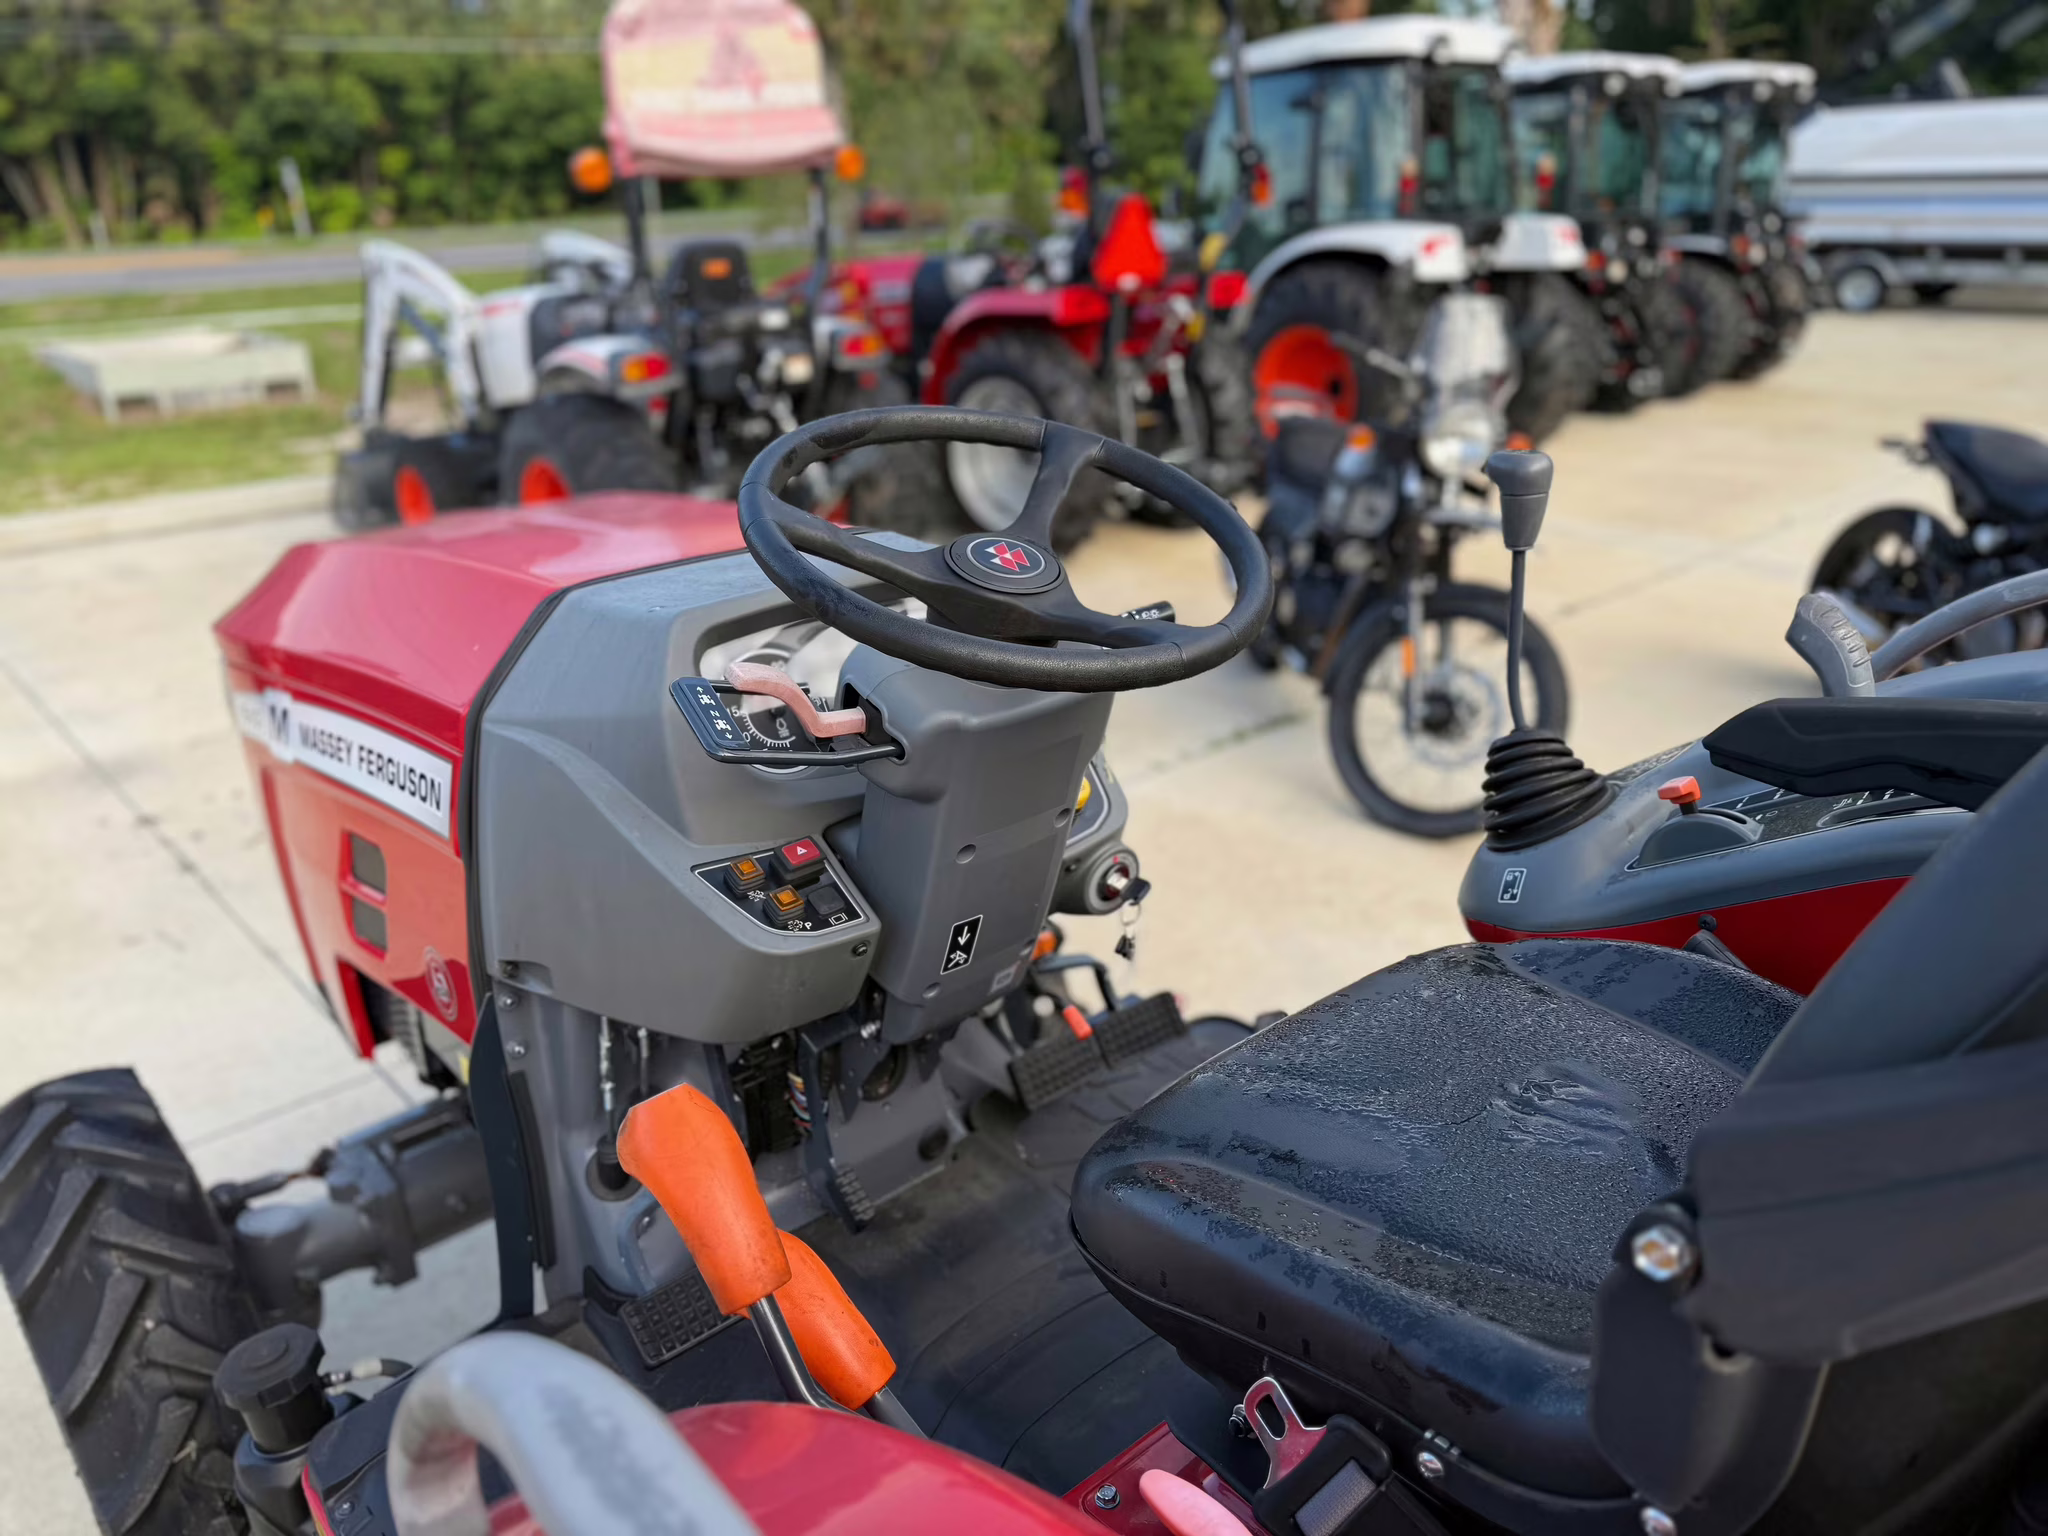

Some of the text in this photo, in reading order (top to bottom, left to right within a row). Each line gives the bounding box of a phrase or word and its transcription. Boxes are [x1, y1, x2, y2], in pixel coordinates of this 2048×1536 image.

[298, 721, 441, 812] MASSEY FERGUSON
[804, 921, 813, 930] P
